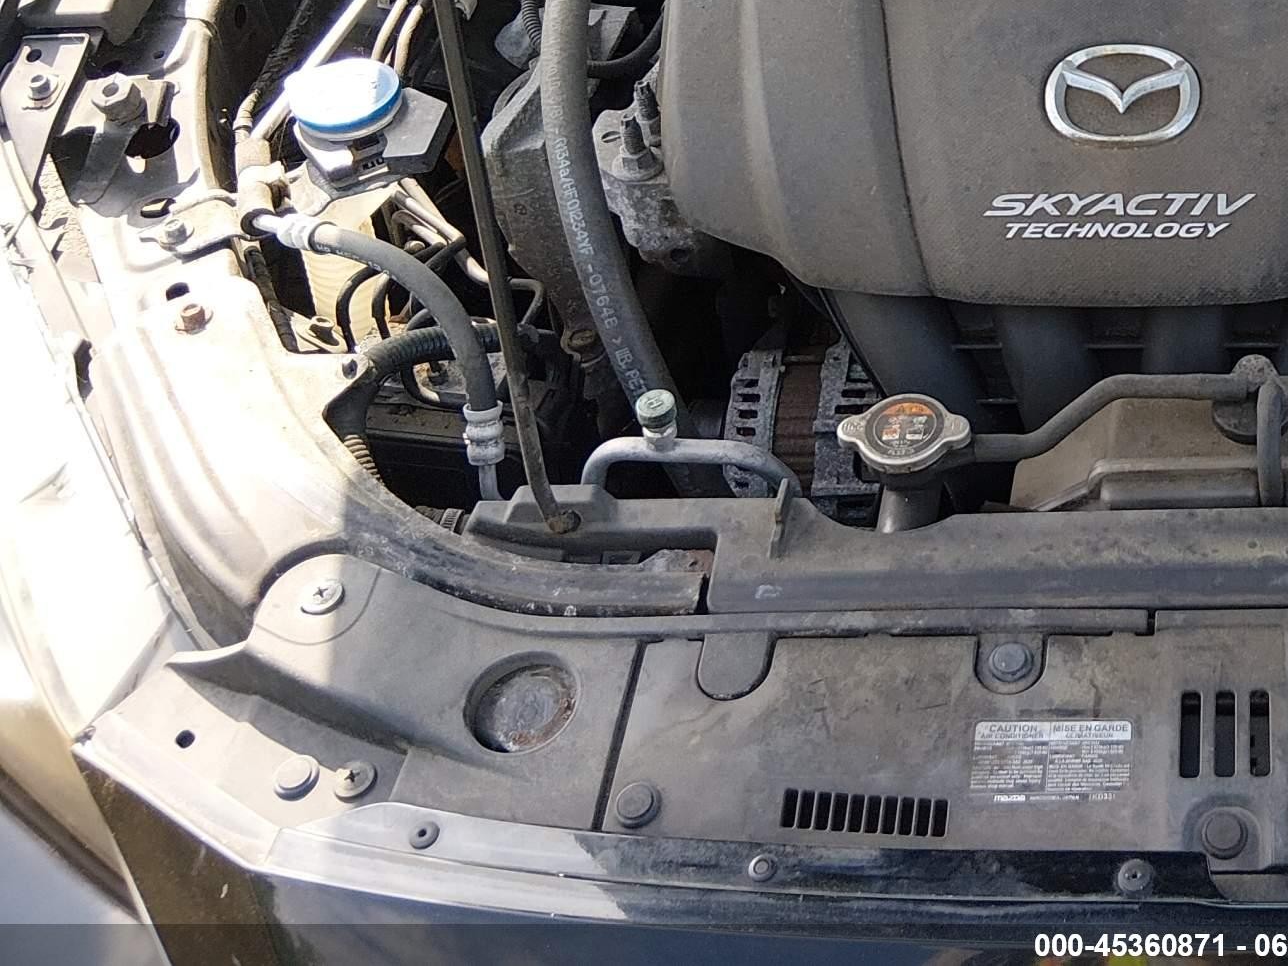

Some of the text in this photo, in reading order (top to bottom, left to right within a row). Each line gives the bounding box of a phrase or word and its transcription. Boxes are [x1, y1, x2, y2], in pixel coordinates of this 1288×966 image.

[983, 193, 1256, 216] SKYACTIV
[1005, 222, 1230, 239] TECHNOLOGY
[990, 724, 1037, 732] CAUTION
[1053, 723, 1129, 732] MISE EN GARDE
[994, 794, 1026, 802] mazda
